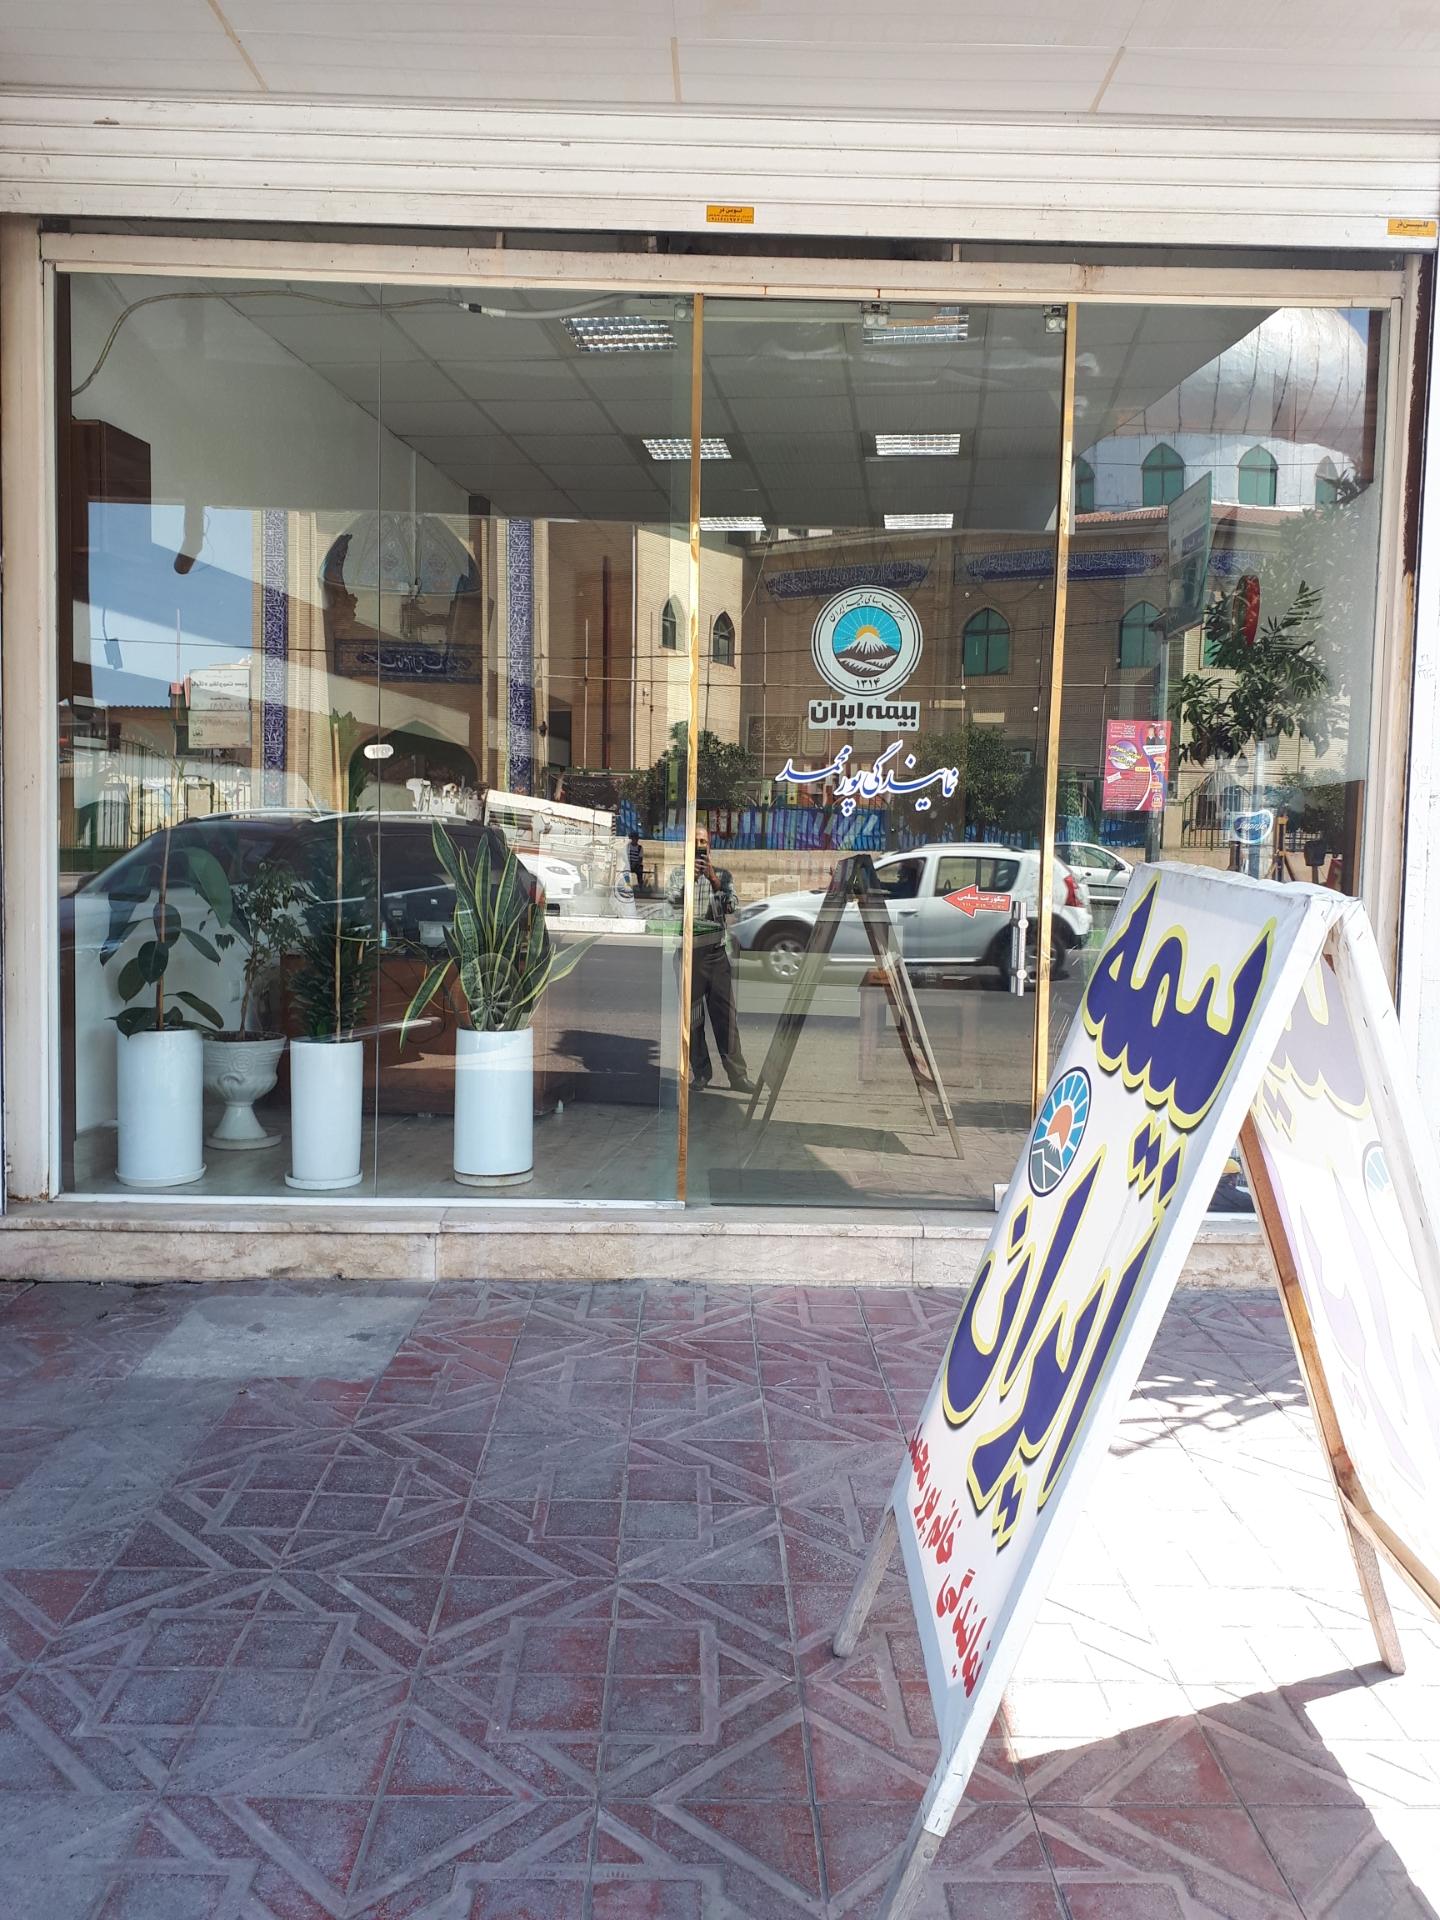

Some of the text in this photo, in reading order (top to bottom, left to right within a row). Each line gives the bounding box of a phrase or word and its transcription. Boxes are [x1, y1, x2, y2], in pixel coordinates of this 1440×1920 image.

[829, 603, 845, 623] ایران
[856, 677, 880, 688] ۱۳۱۴
[810, 701, 917, 727] بیمه ایران
[861, 740, 960, 811] نمایندگی
[1082, 871, 1278, 1220] بیمه
[943, 1144, 1165, 1547] ایران
